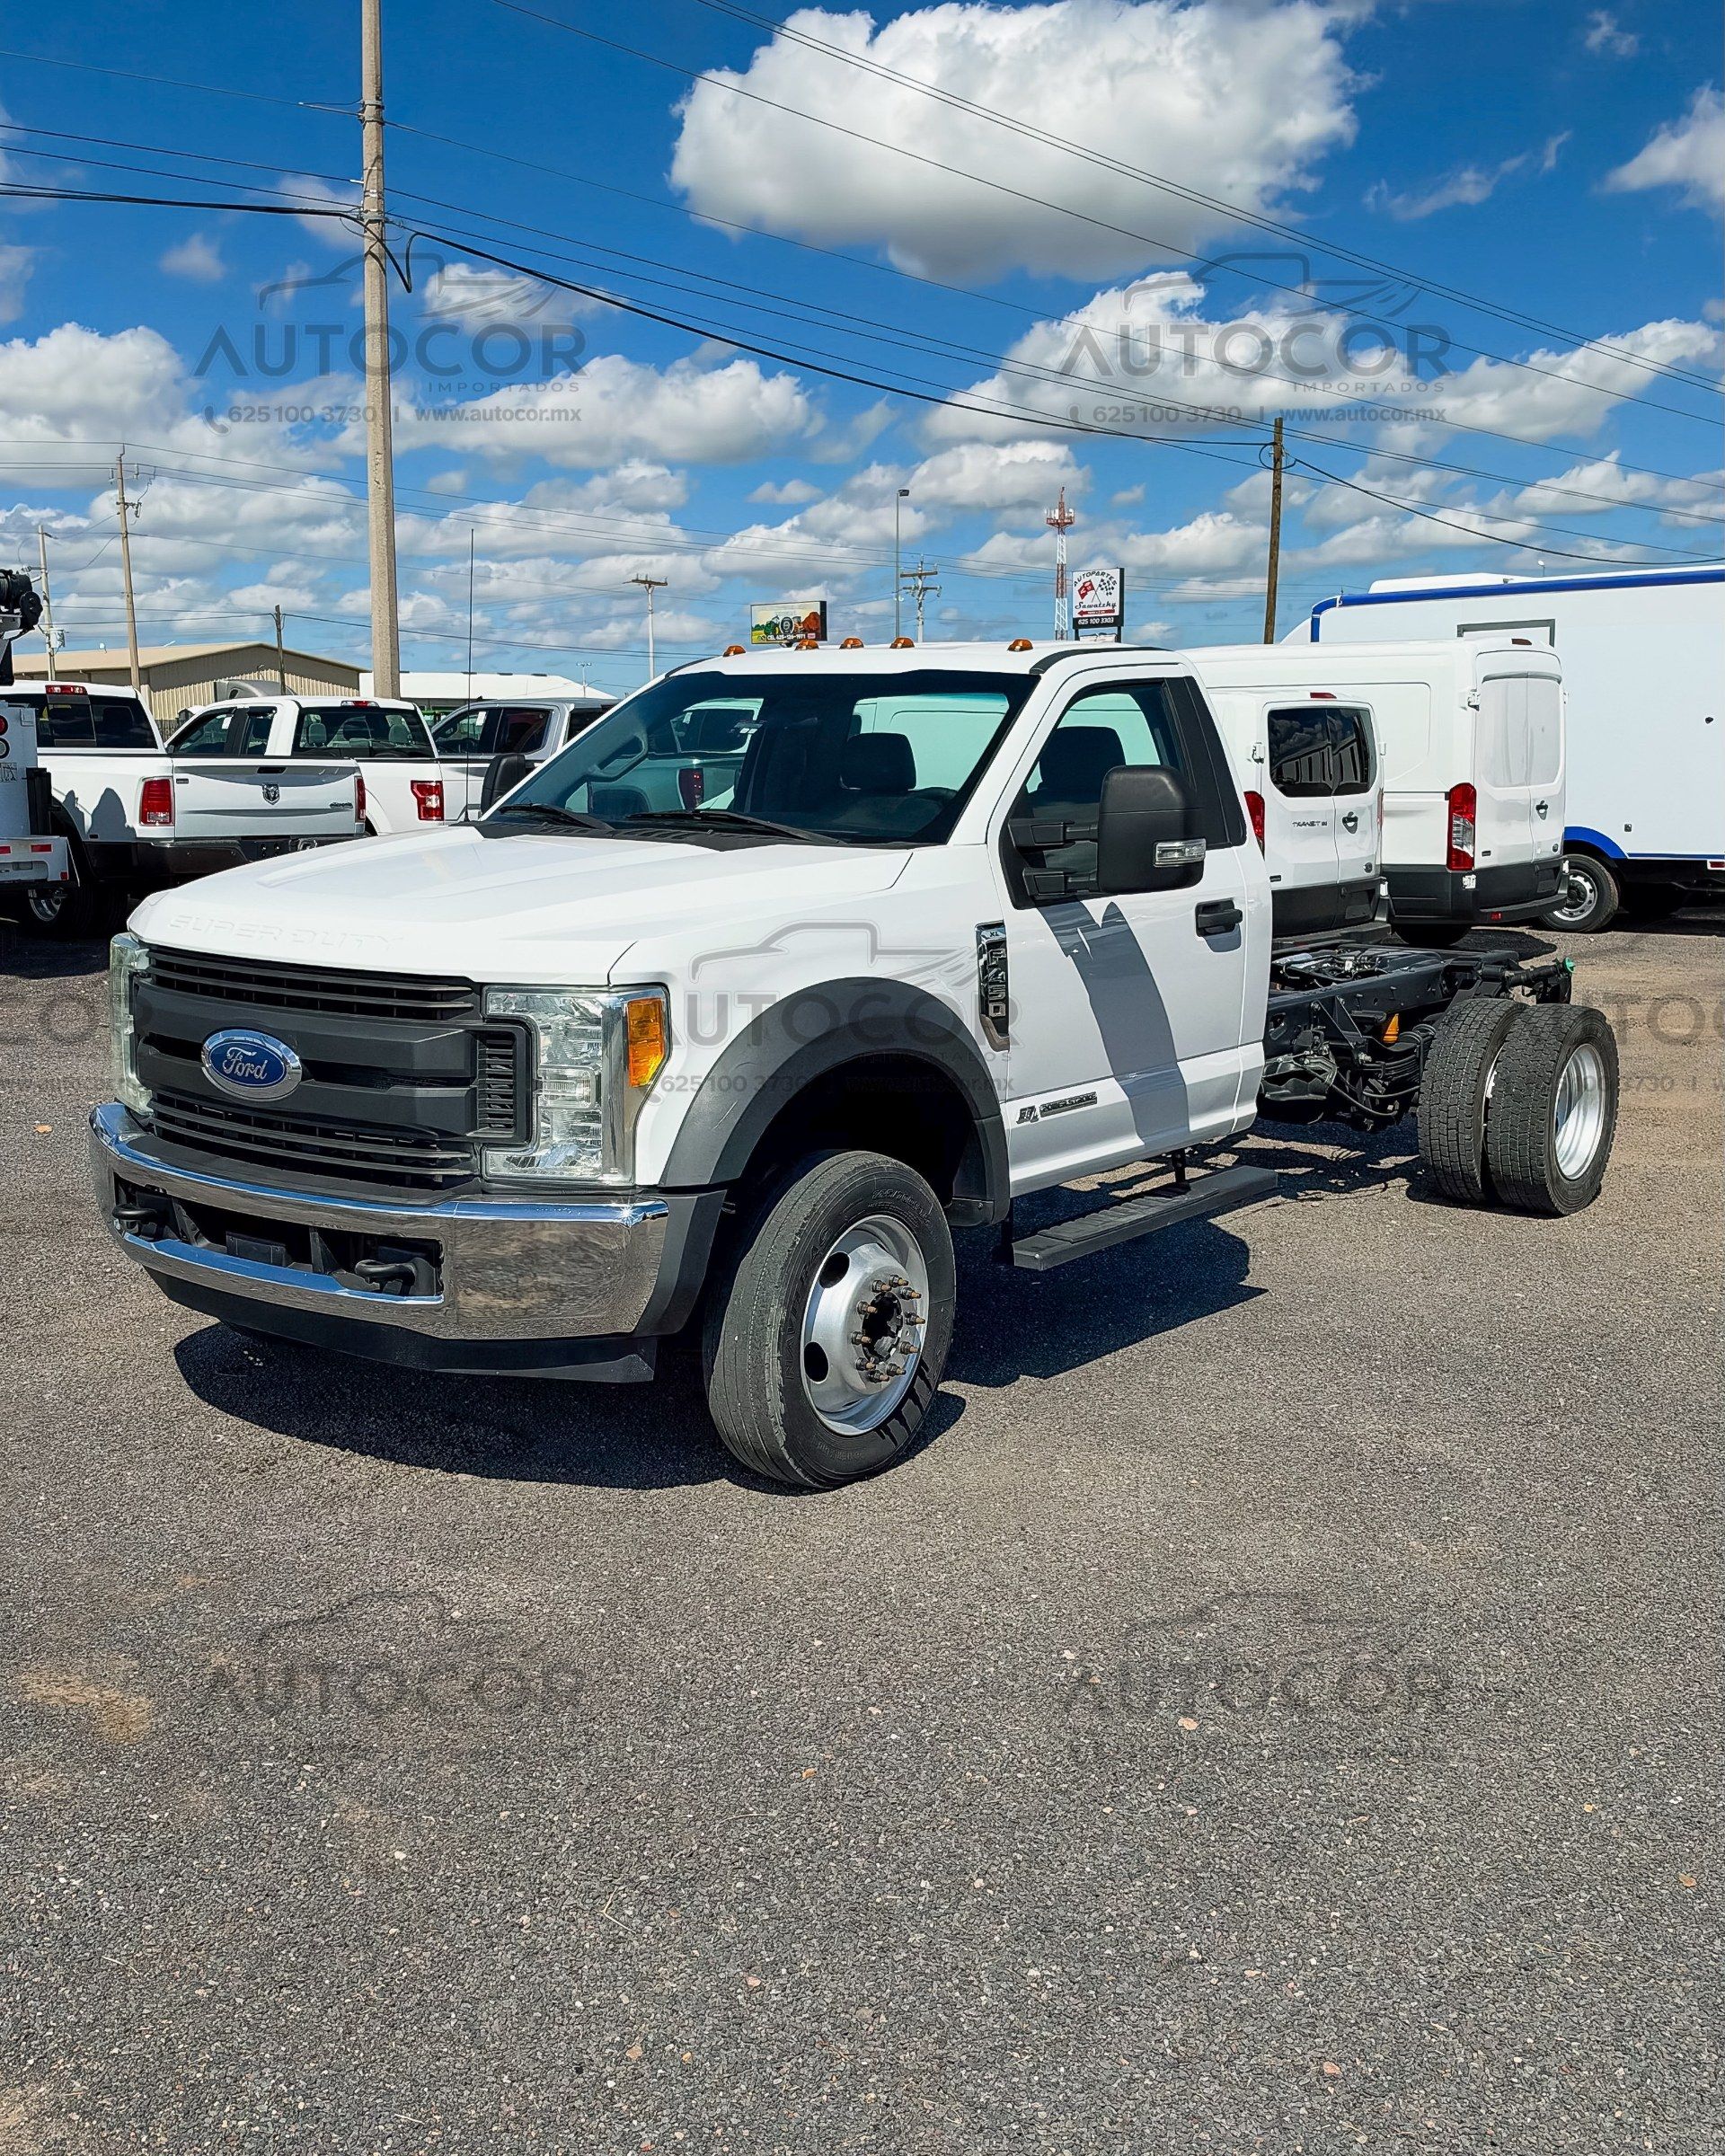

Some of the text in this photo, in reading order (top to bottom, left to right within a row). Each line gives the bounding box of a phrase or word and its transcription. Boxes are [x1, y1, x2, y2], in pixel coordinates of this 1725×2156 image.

[1074, 570, 1118, 588] AUTOPARTES
[168, 915, 404, 951] SUPER DUTY
[223, 1047, 268, 1081] Ford
